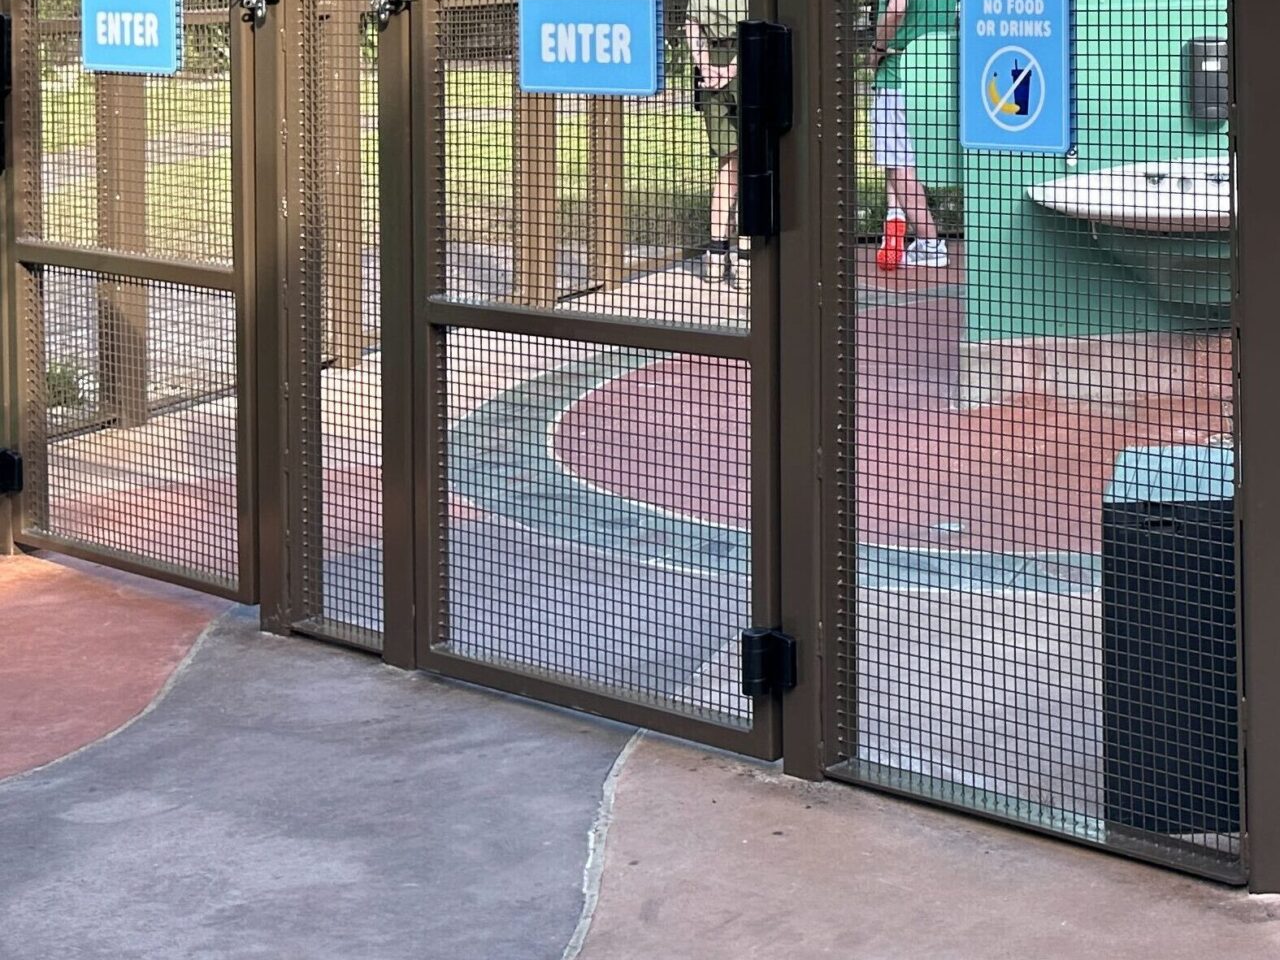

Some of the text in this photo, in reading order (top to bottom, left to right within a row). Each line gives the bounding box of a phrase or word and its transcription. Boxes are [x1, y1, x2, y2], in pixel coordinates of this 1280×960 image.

[96, 11, 159, 48] ENTER
[541, 22, 632, 65] ENTER
[976, 20, 1052, 38] OR DRINKS
